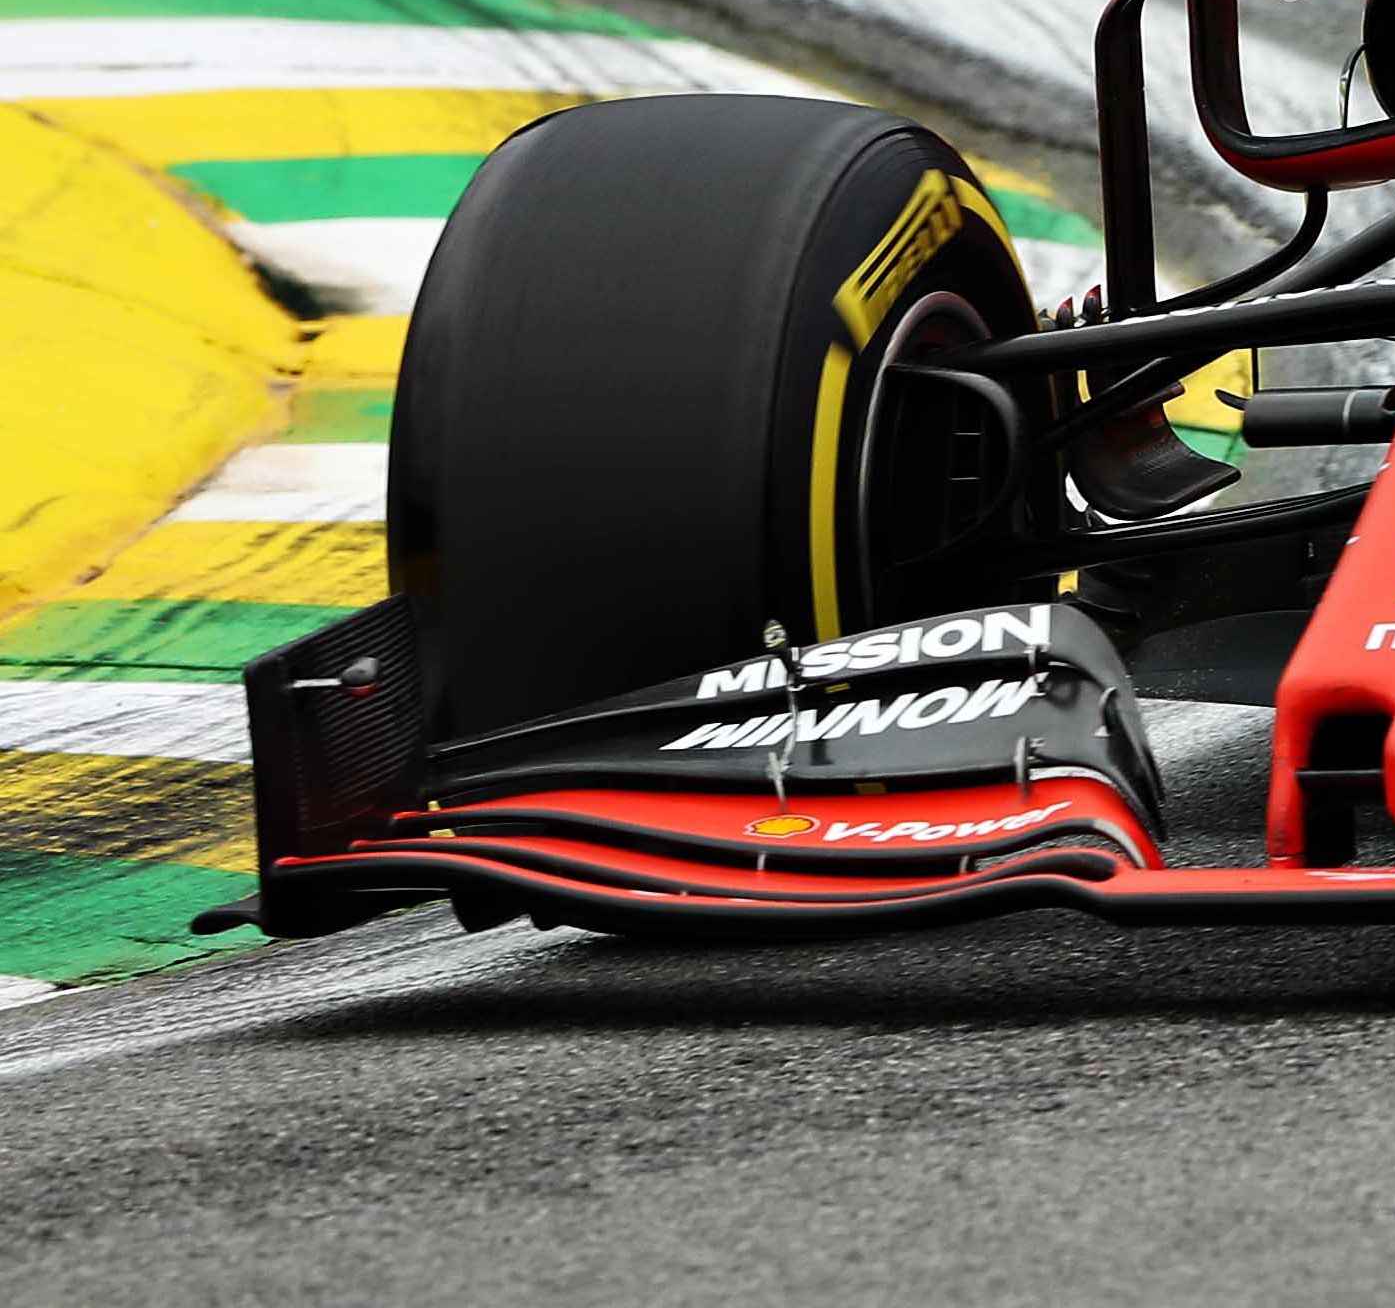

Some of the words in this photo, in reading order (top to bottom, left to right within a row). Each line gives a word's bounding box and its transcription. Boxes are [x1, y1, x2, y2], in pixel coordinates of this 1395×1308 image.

[695, 603, 1054, 700] MISSION
[658, 672, 1050, 752] WINNOW
[820, 799, 1072, 844] V-Power
